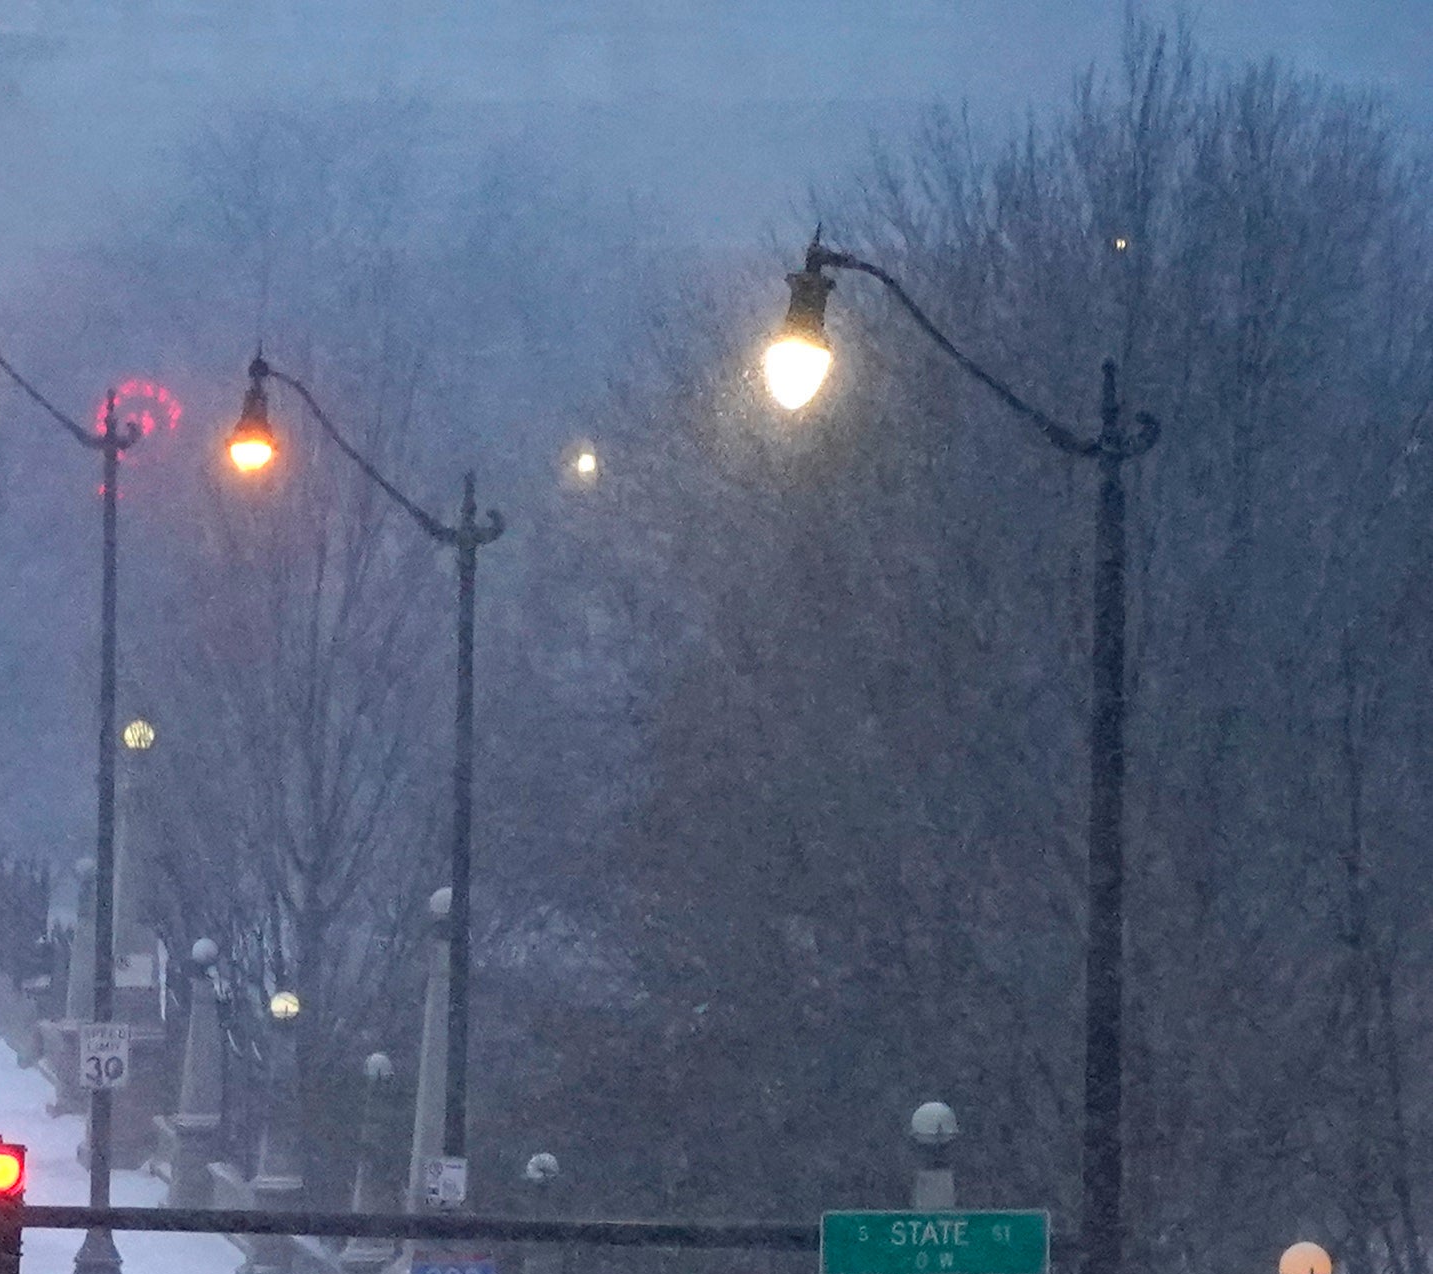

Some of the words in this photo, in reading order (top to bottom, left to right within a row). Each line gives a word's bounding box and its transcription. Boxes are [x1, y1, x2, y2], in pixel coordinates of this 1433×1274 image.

[85, 1055, 124, 1081] 30
[891, 1221, 969, 1245] STATE
[992, 1225, 1021, 1241] ST
[939, 1252, 954, 1269] W
